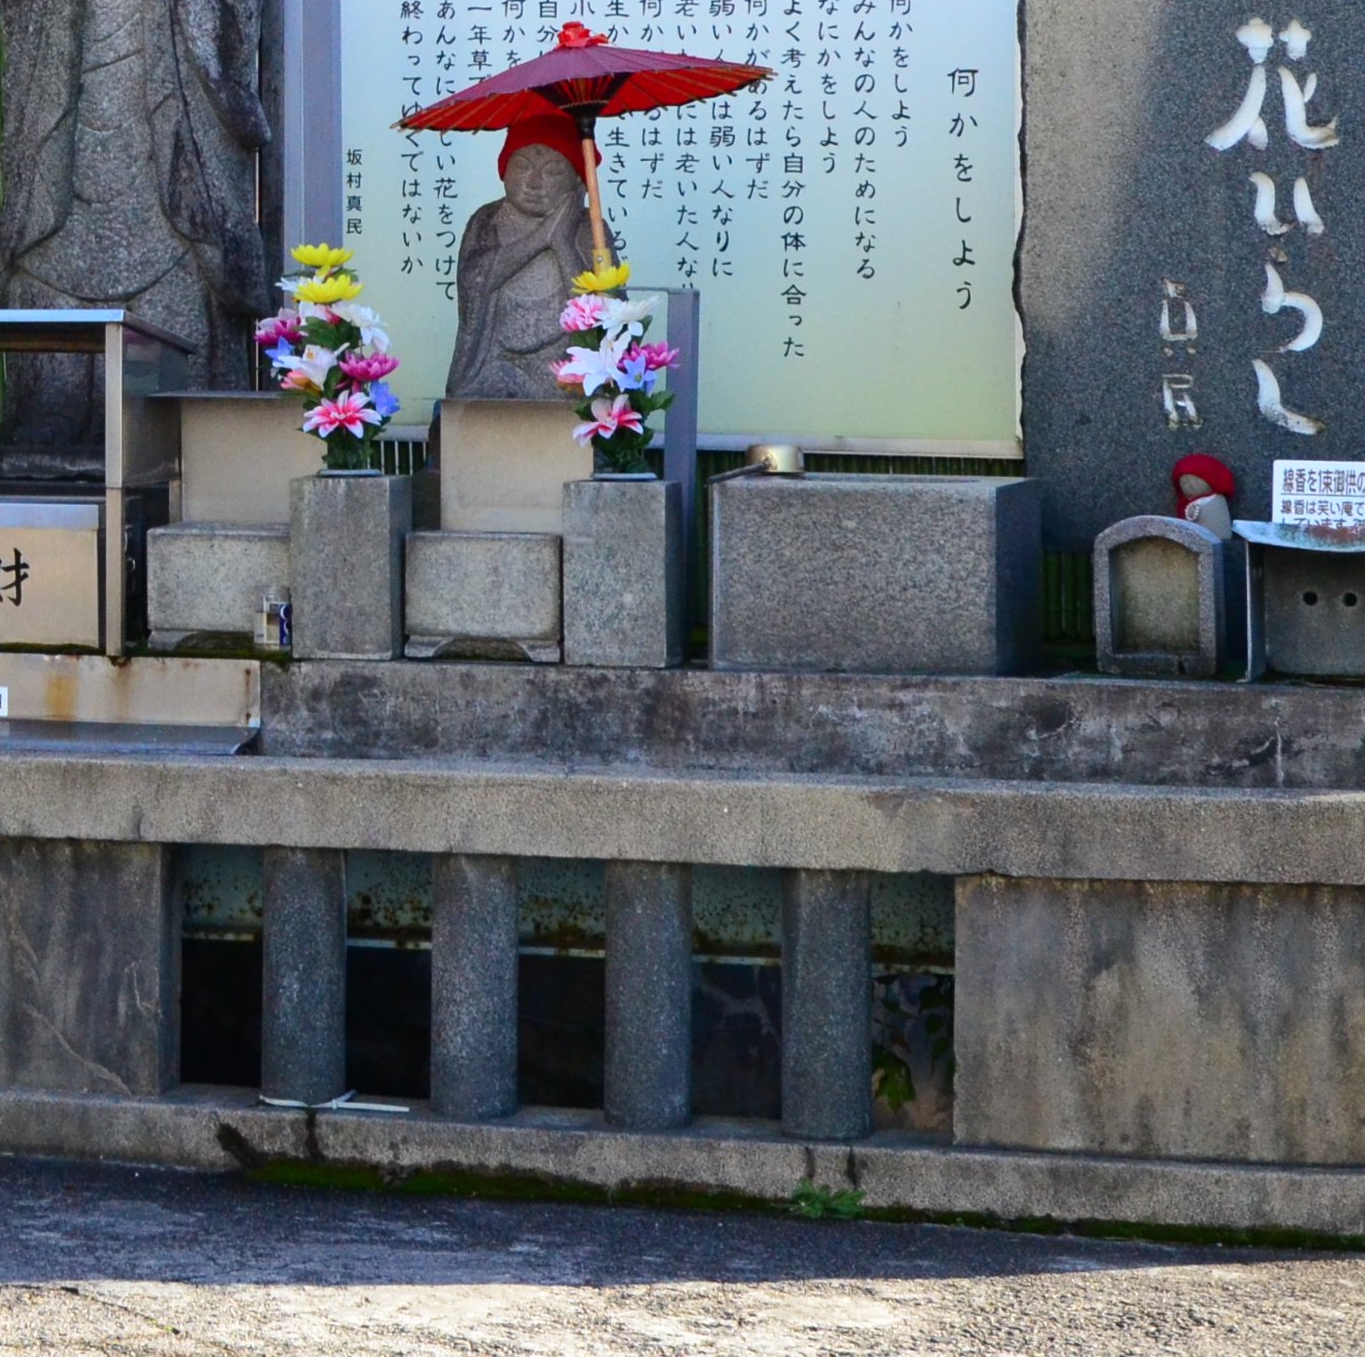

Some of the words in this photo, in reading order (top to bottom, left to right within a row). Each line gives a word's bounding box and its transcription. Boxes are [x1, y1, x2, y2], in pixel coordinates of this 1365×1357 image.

[345, 148, 363, 236] 坂村真民
[433, 0, 459, 301] あんなにしい花をつけて
[945, 68, 979, 311] 何かをしよう
